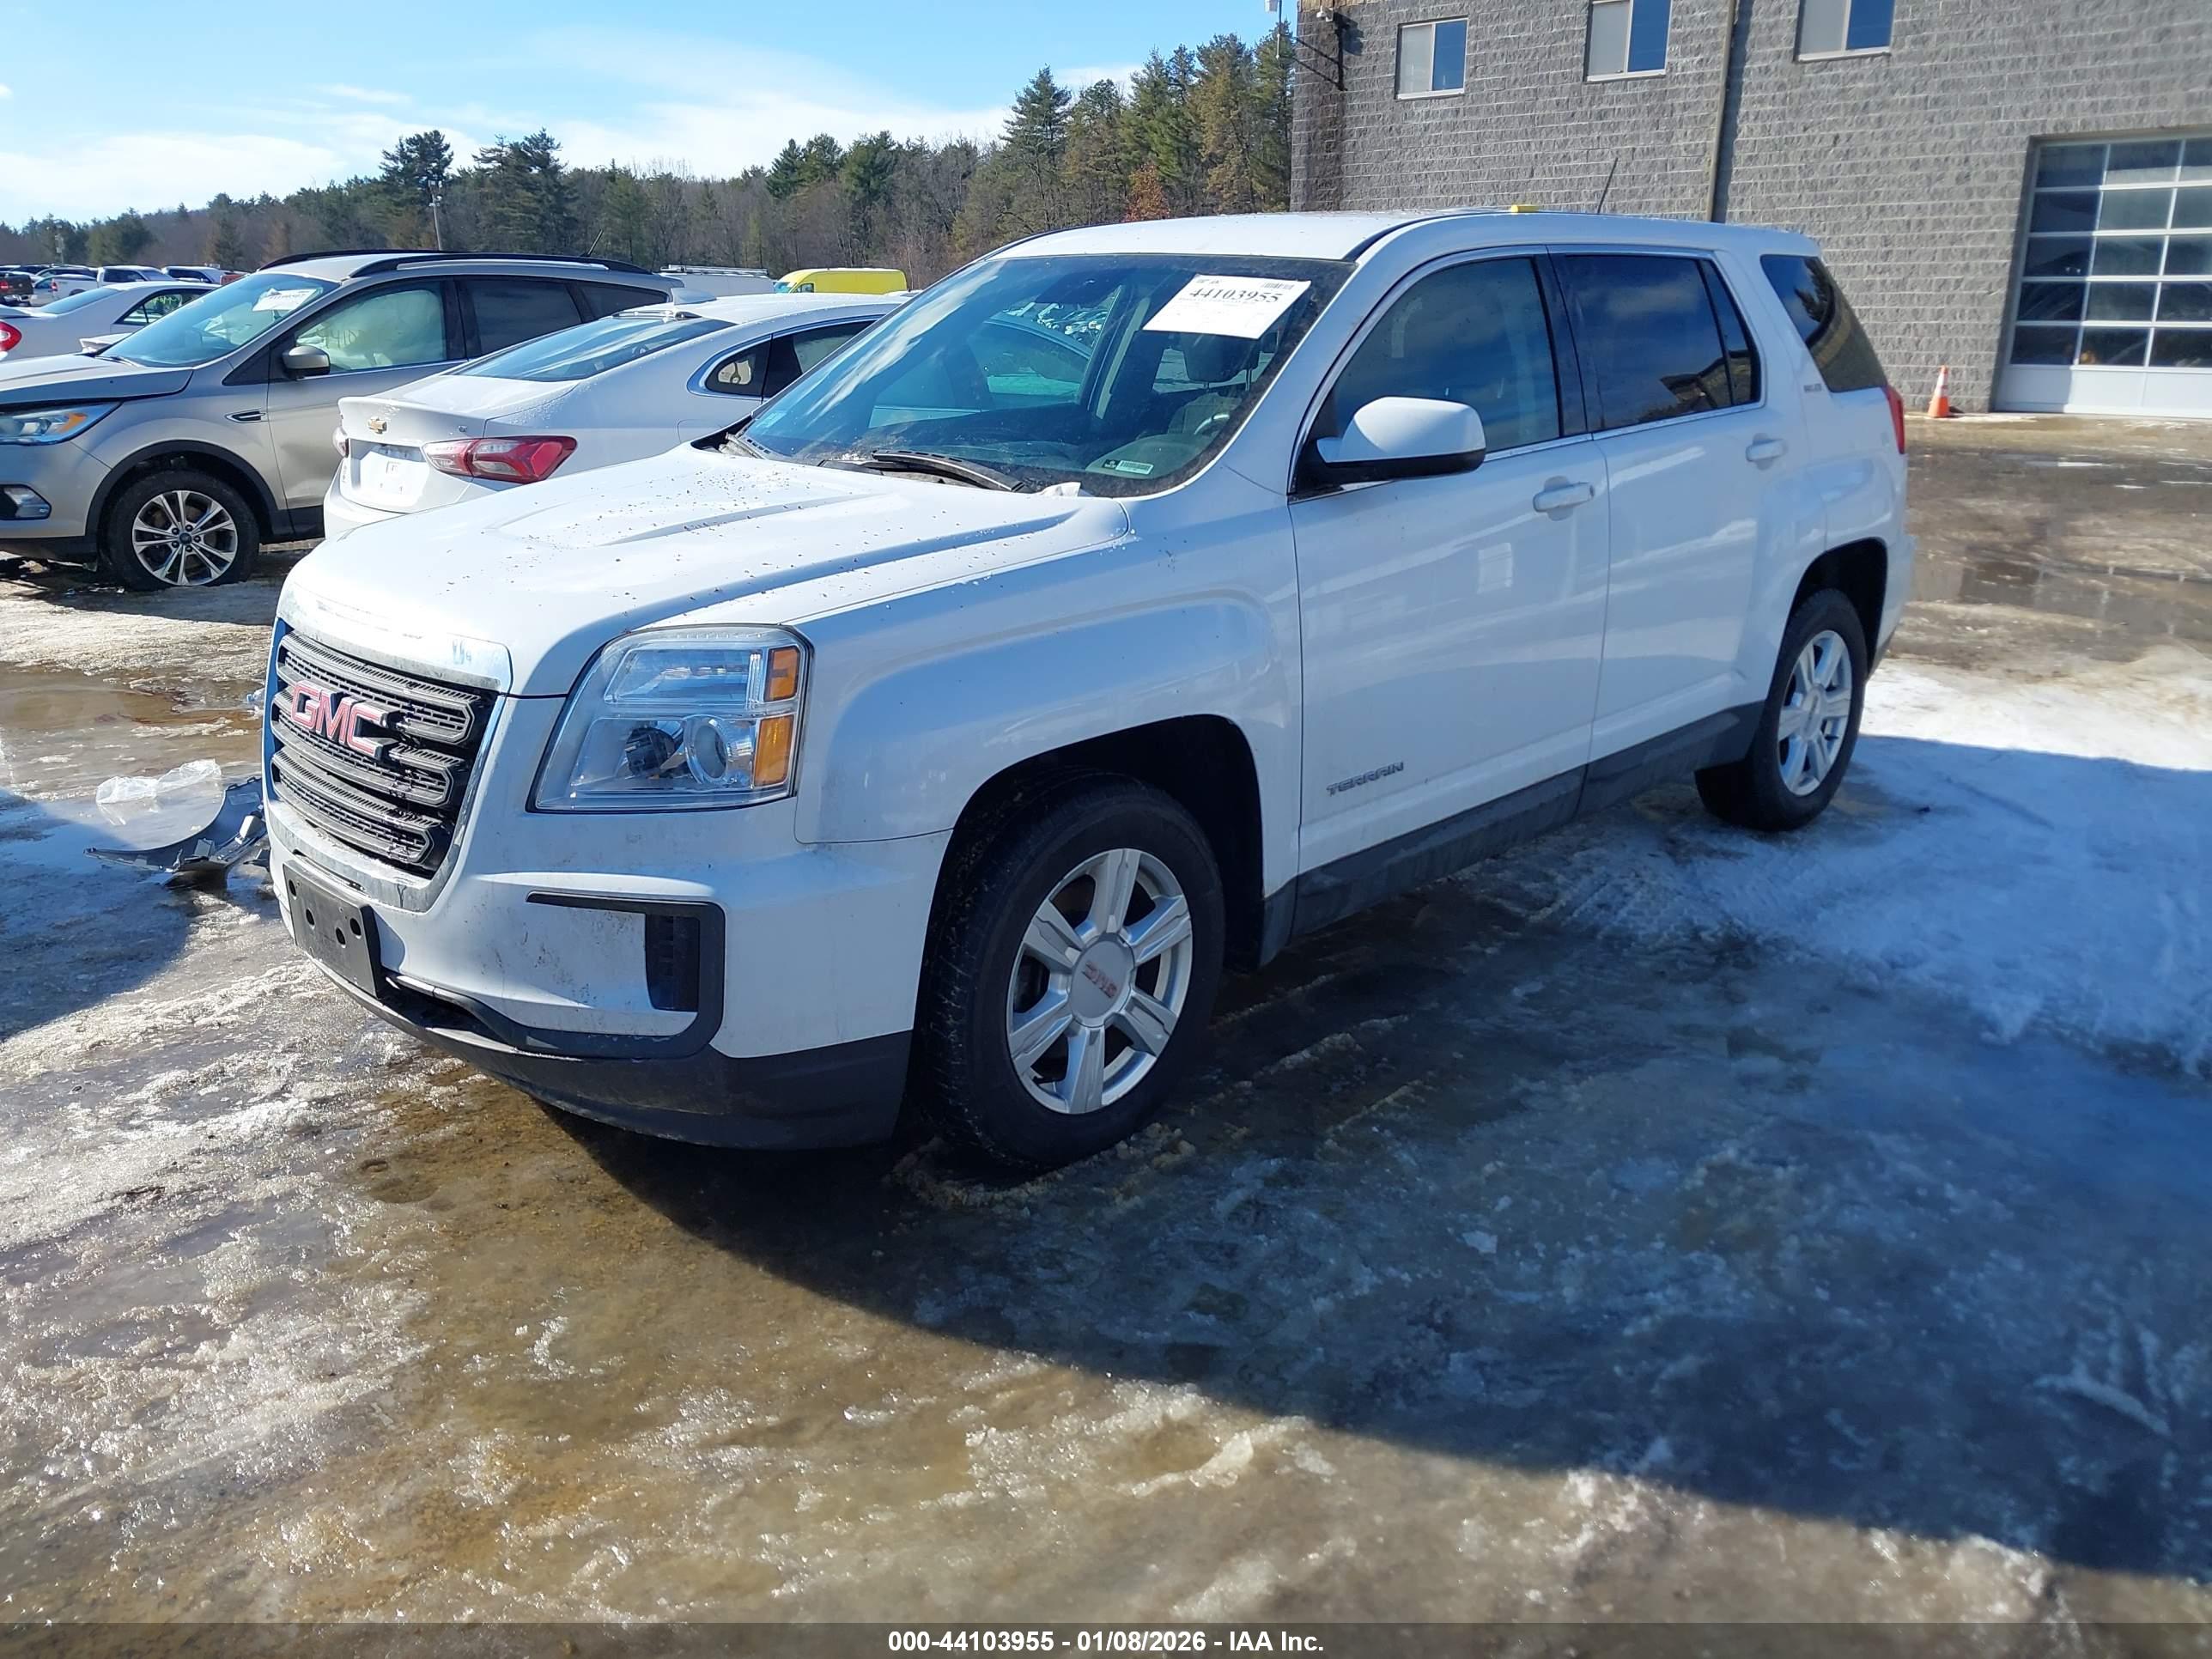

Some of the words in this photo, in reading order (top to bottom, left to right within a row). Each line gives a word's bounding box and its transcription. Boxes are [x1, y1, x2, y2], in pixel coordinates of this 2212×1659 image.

[1189, 288, 1284, 303] 44103955
[290, 680, 394, 759] GMC
[1326, 762, 1404, 797] TERRAIN
